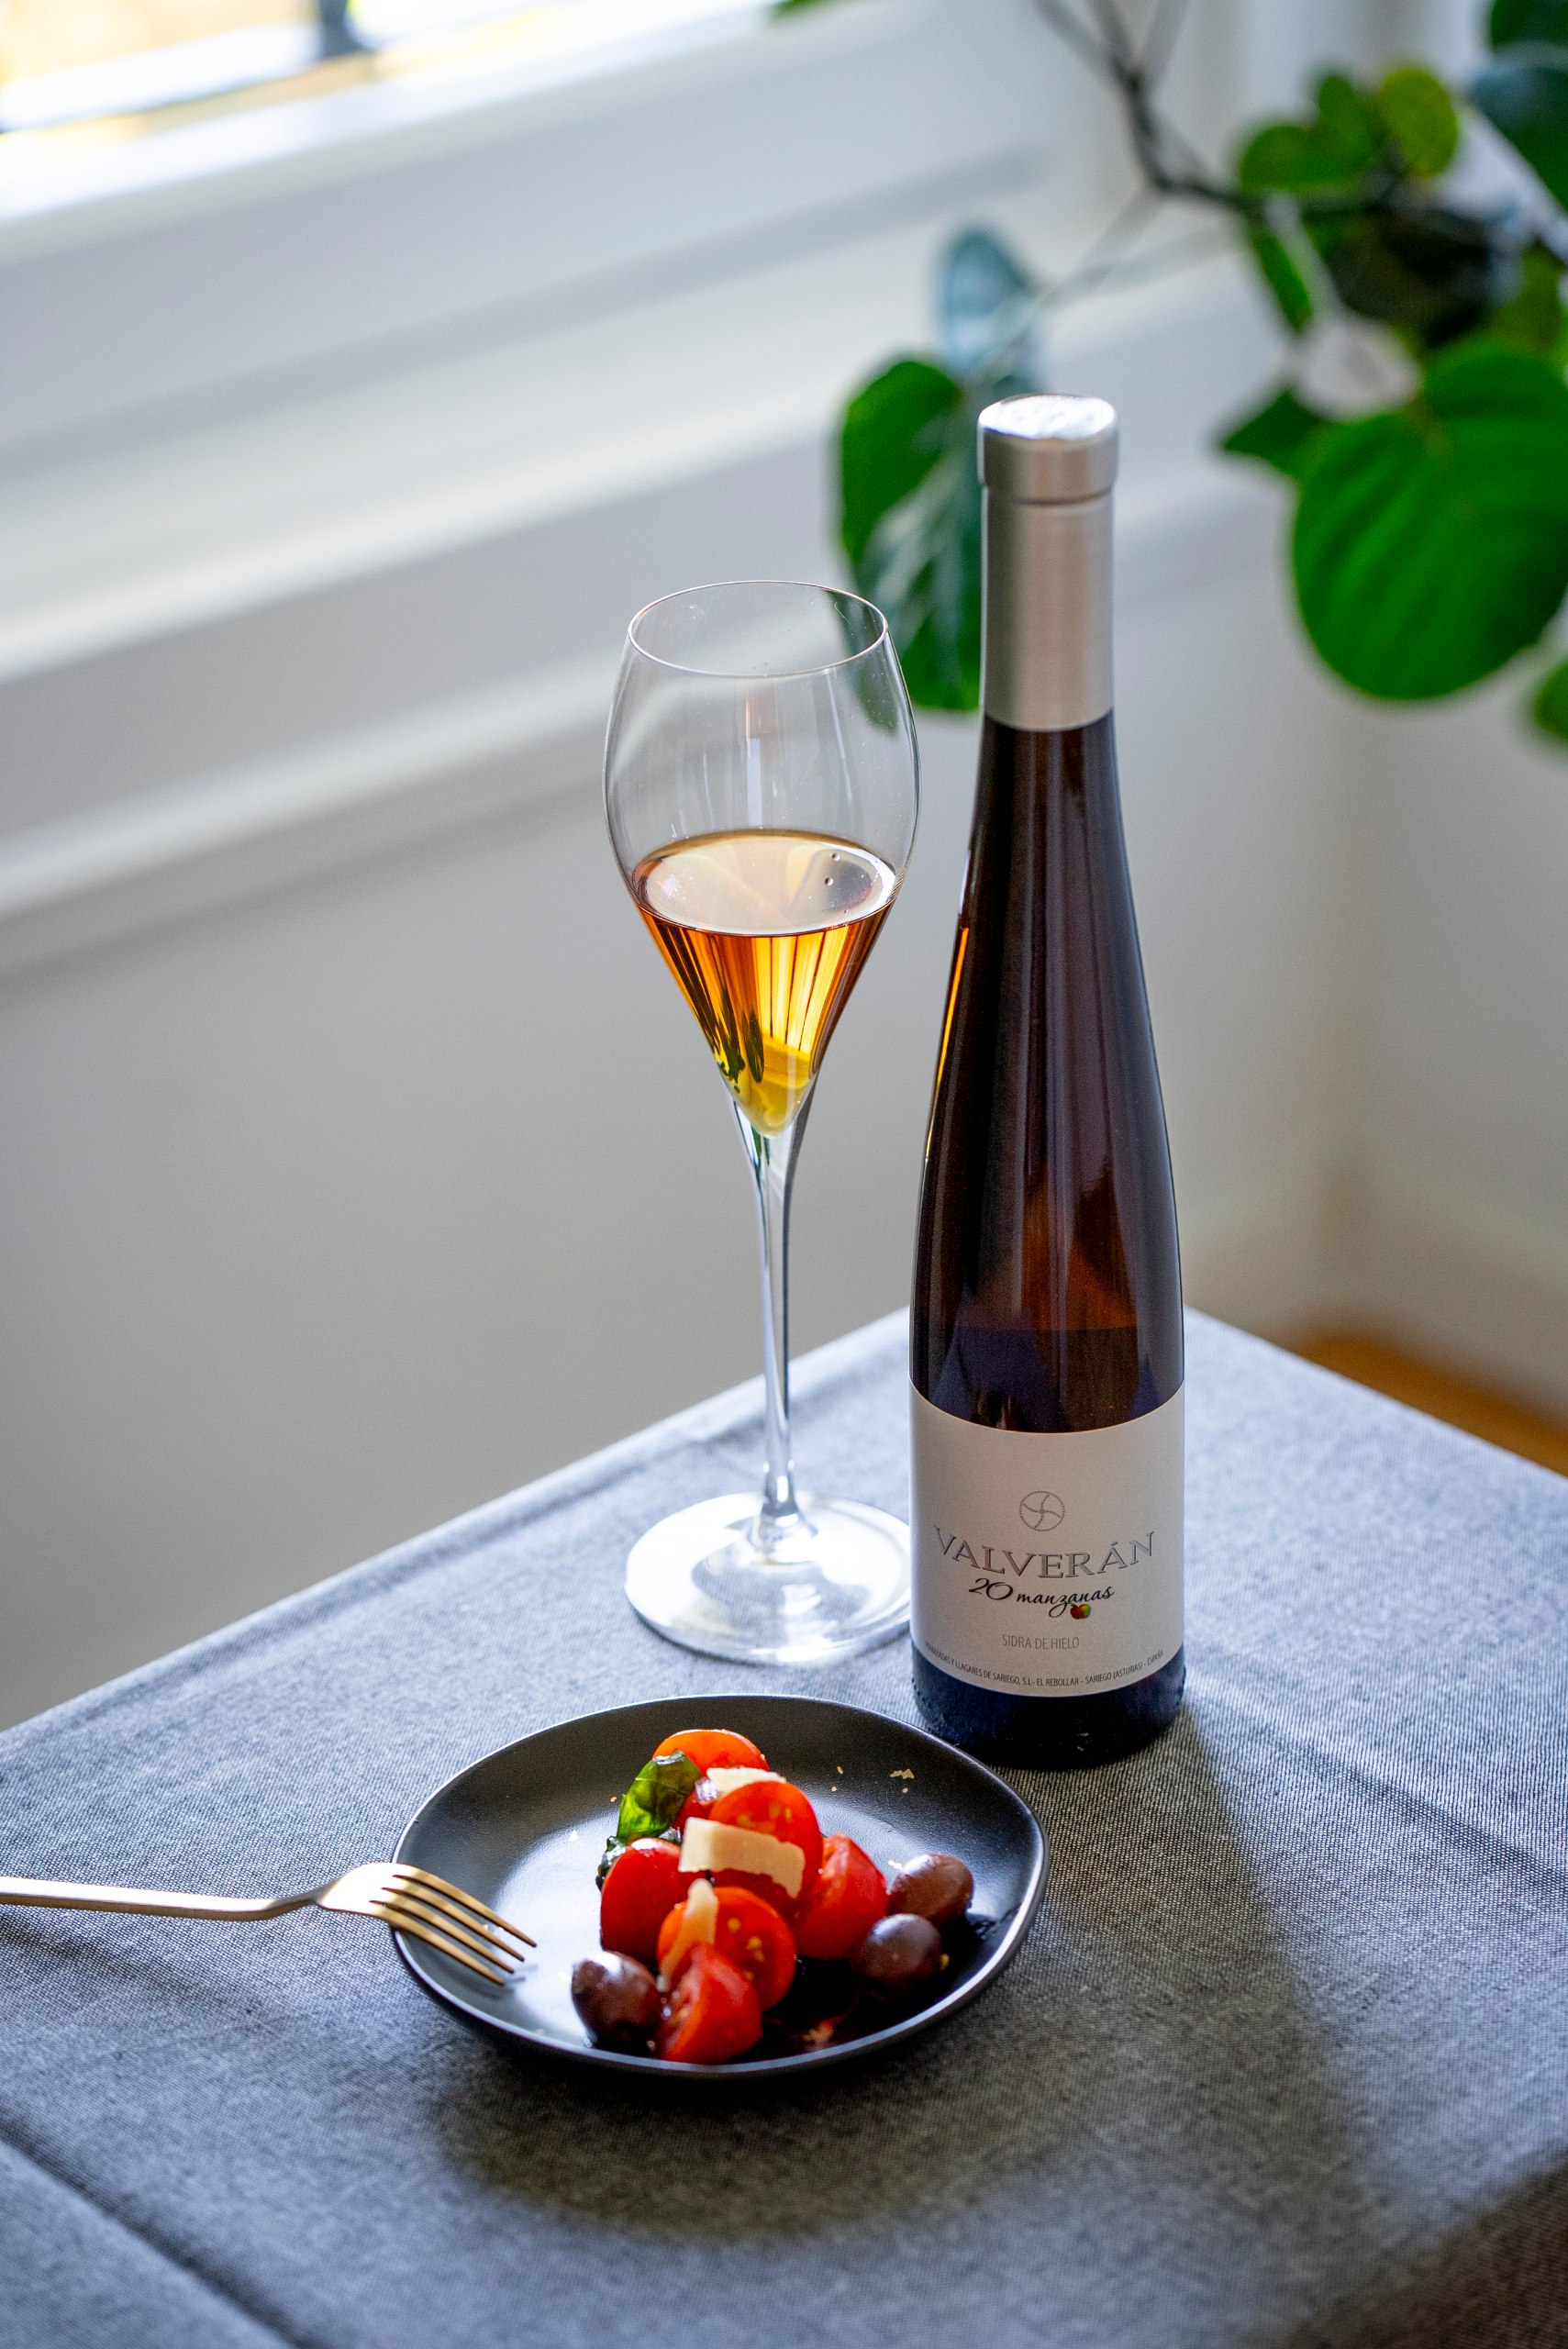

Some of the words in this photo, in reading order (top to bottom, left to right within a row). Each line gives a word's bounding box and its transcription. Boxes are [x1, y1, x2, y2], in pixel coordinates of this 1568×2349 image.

[933, 1524, 1155, 1578] VALVERÁN
[968, 1577, 1014, 1601] 20
[1017, 1586, 1115, 1619] manzanas
[1002, 1633, 1032, 1649] SIDRA
[1034, 1637, 1049, 1650] DE
[1051, 1636, 1080, 1650] HIELO
[983, 1669, 992, 1679] DE
[1036, 1677, 1044, 1687] EL
[1045, 1677, 1079, 1687] REBOLLAR
[1084, 1672, 1112, 1685] SARIEGO
[1113, 1662, 1143, 1679] (ASTURIAS)
